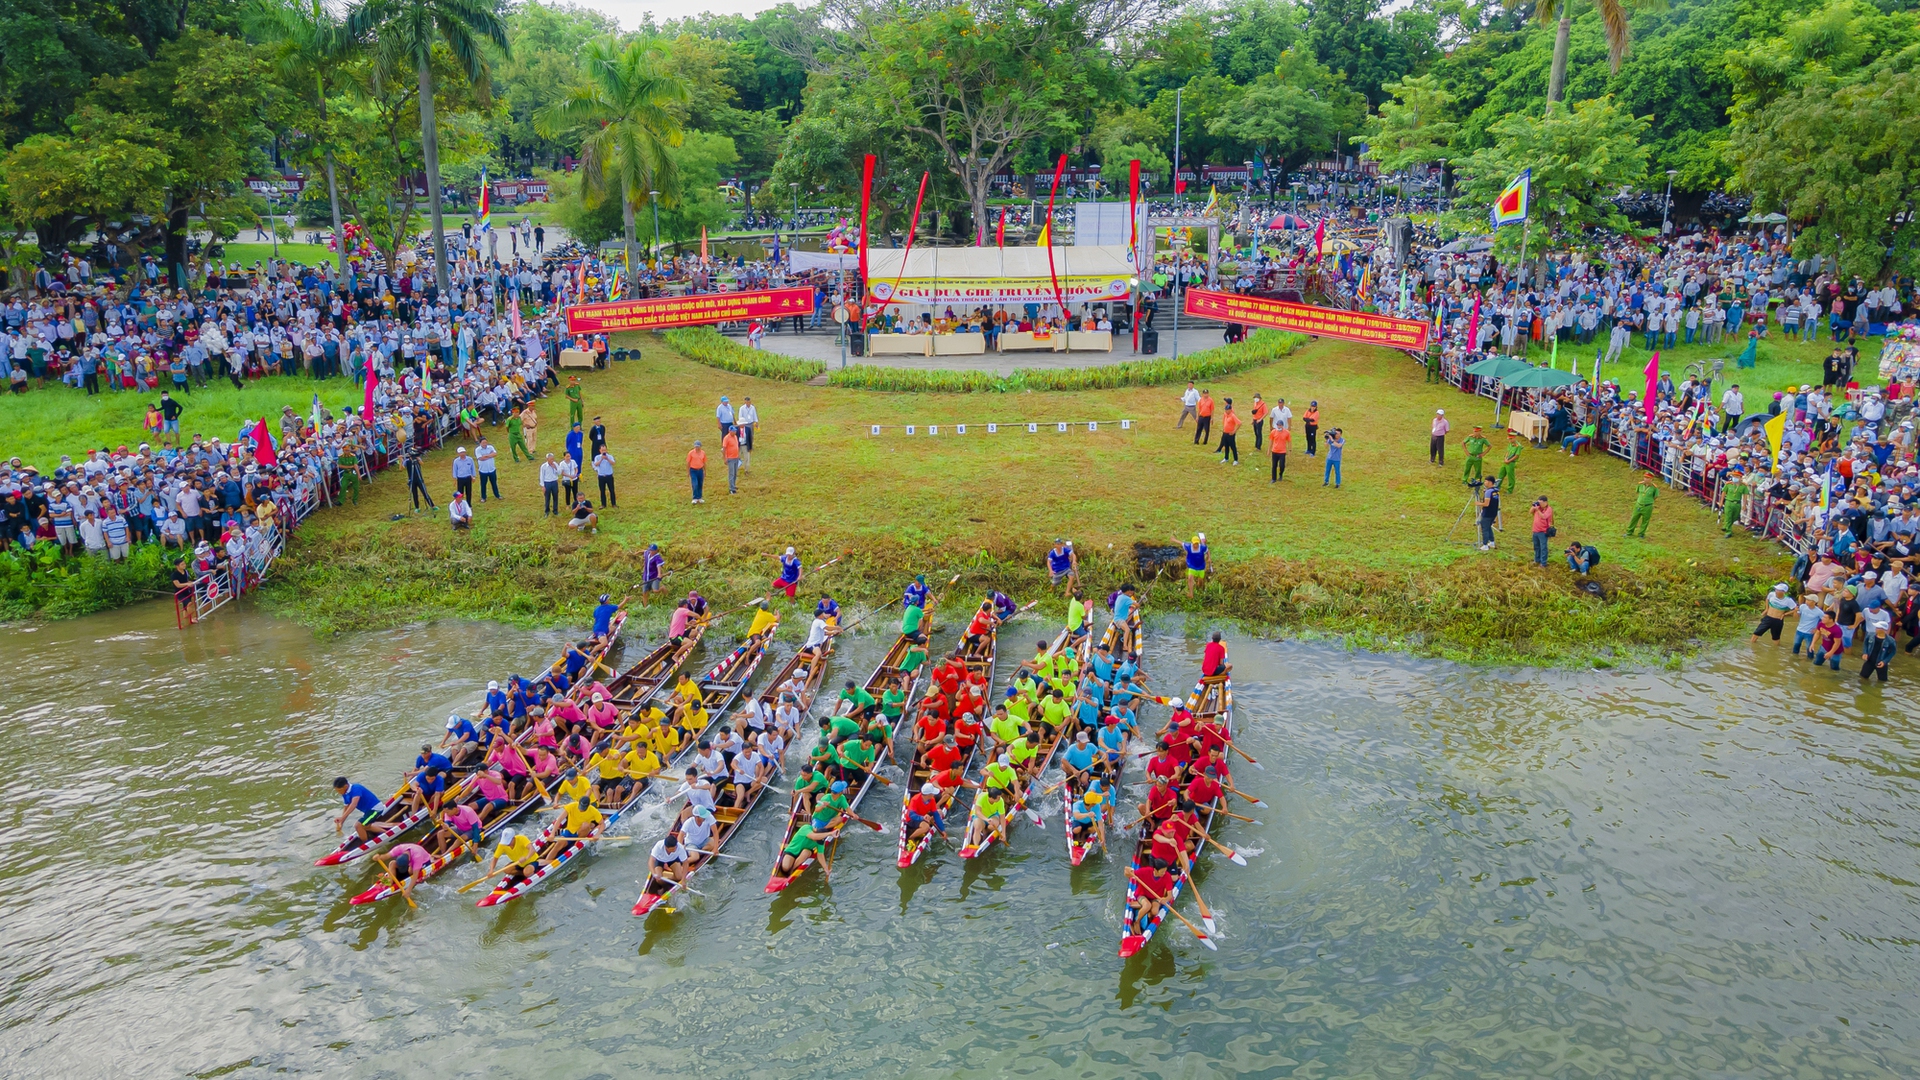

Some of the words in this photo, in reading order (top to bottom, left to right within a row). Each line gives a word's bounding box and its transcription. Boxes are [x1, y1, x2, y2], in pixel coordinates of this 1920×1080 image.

[965, 289, 994, 297] GHE
[997, 284, 1052, 296] TRUYỀN
[1349, 327, 1361, 336] NAM
